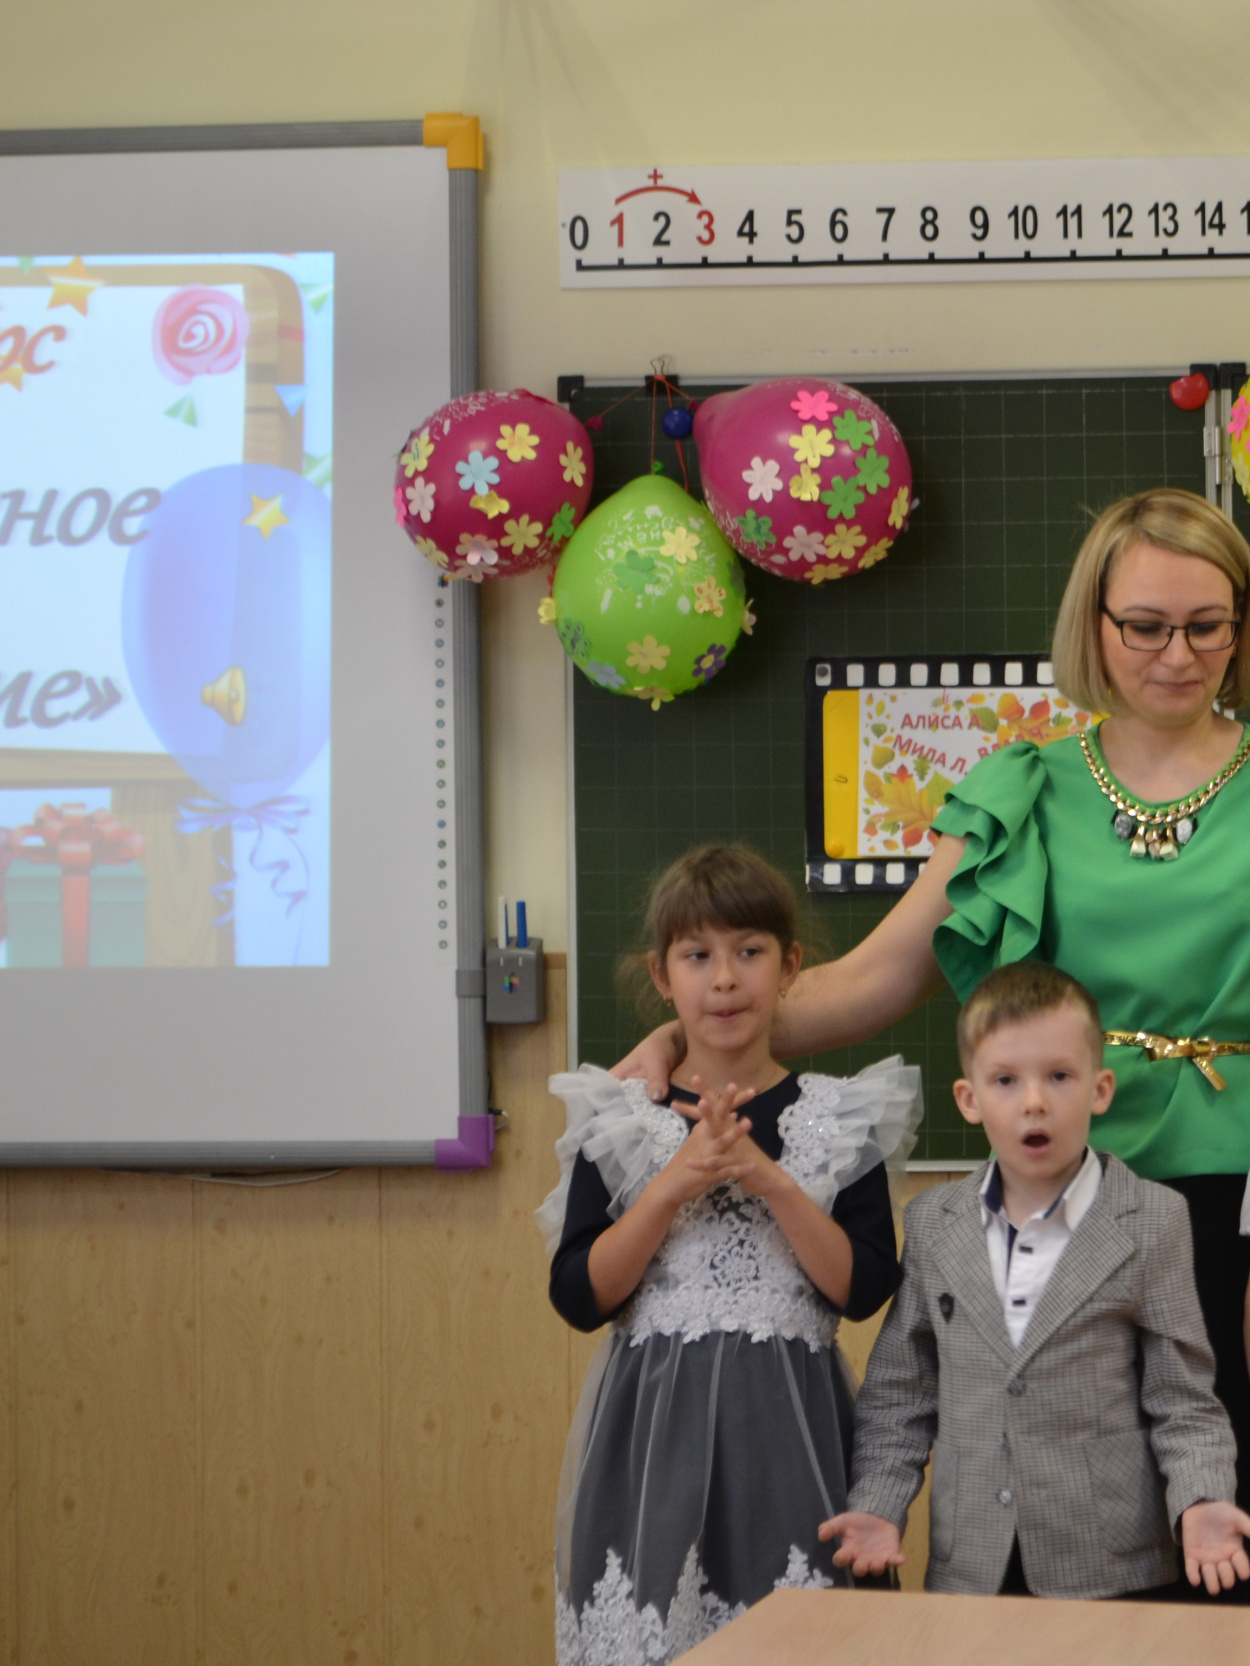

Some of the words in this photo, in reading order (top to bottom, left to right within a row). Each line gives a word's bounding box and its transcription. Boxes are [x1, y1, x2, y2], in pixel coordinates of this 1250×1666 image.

[569, 215, 589, 251] 0
[609, 212, 625, 248] 1
[652, 211, 671, 247] 2
[696, 210, 715, 246] 3
[736, 209, 758, 245] 4
[785, 209, 805, 244] 5
[829, 208, 849, 244] 6
[876, 207, 896, 243] 7
[919, 206, 939, 242] 8
[969, 205, 989, 241] 9
[1007, 204, 1038, 240] 10
[1056, 203, 1083, 240] 11
[1102, 203, 1133, 239] 12
[1148, 202, 1179, 238] 13
[1194, 201, 1226, 237] 14
[0, 487, 162, 547] ное
[901, 713, 963, 730] АЛИСА
